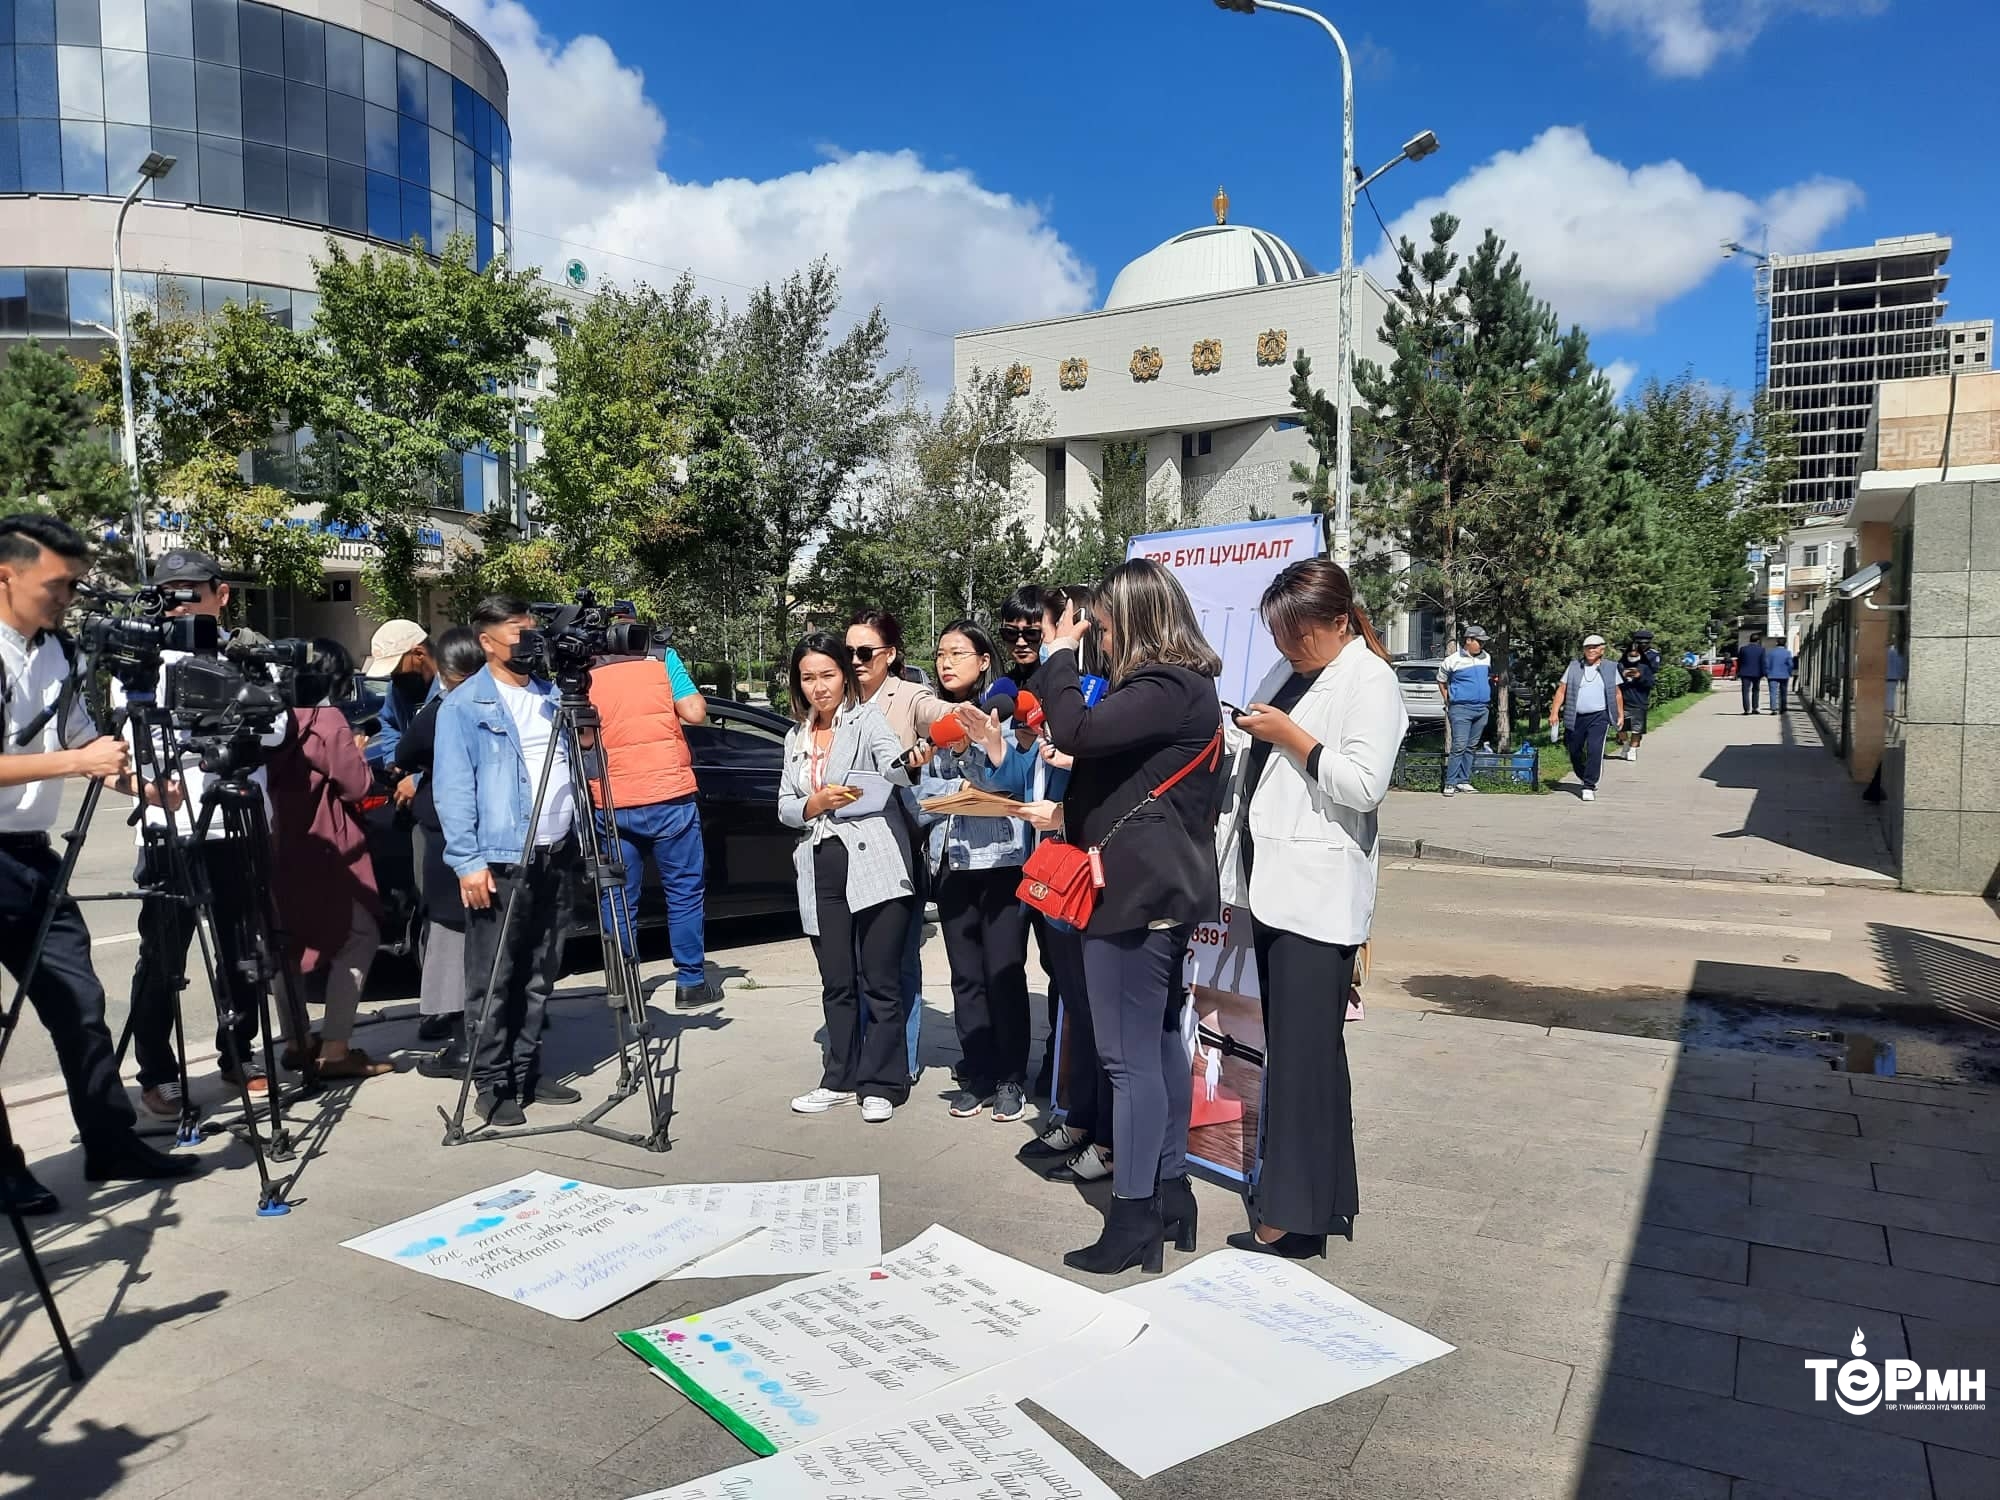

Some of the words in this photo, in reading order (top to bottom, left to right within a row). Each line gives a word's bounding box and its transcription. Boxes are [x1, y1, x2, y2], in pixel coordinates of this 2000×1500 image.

[1174, 547, 1204, 568] БҮЛ
[1209, 538, 1294, 567] ЦУЦЛАЛТ
[1222, 906, 1232, 924] 6
